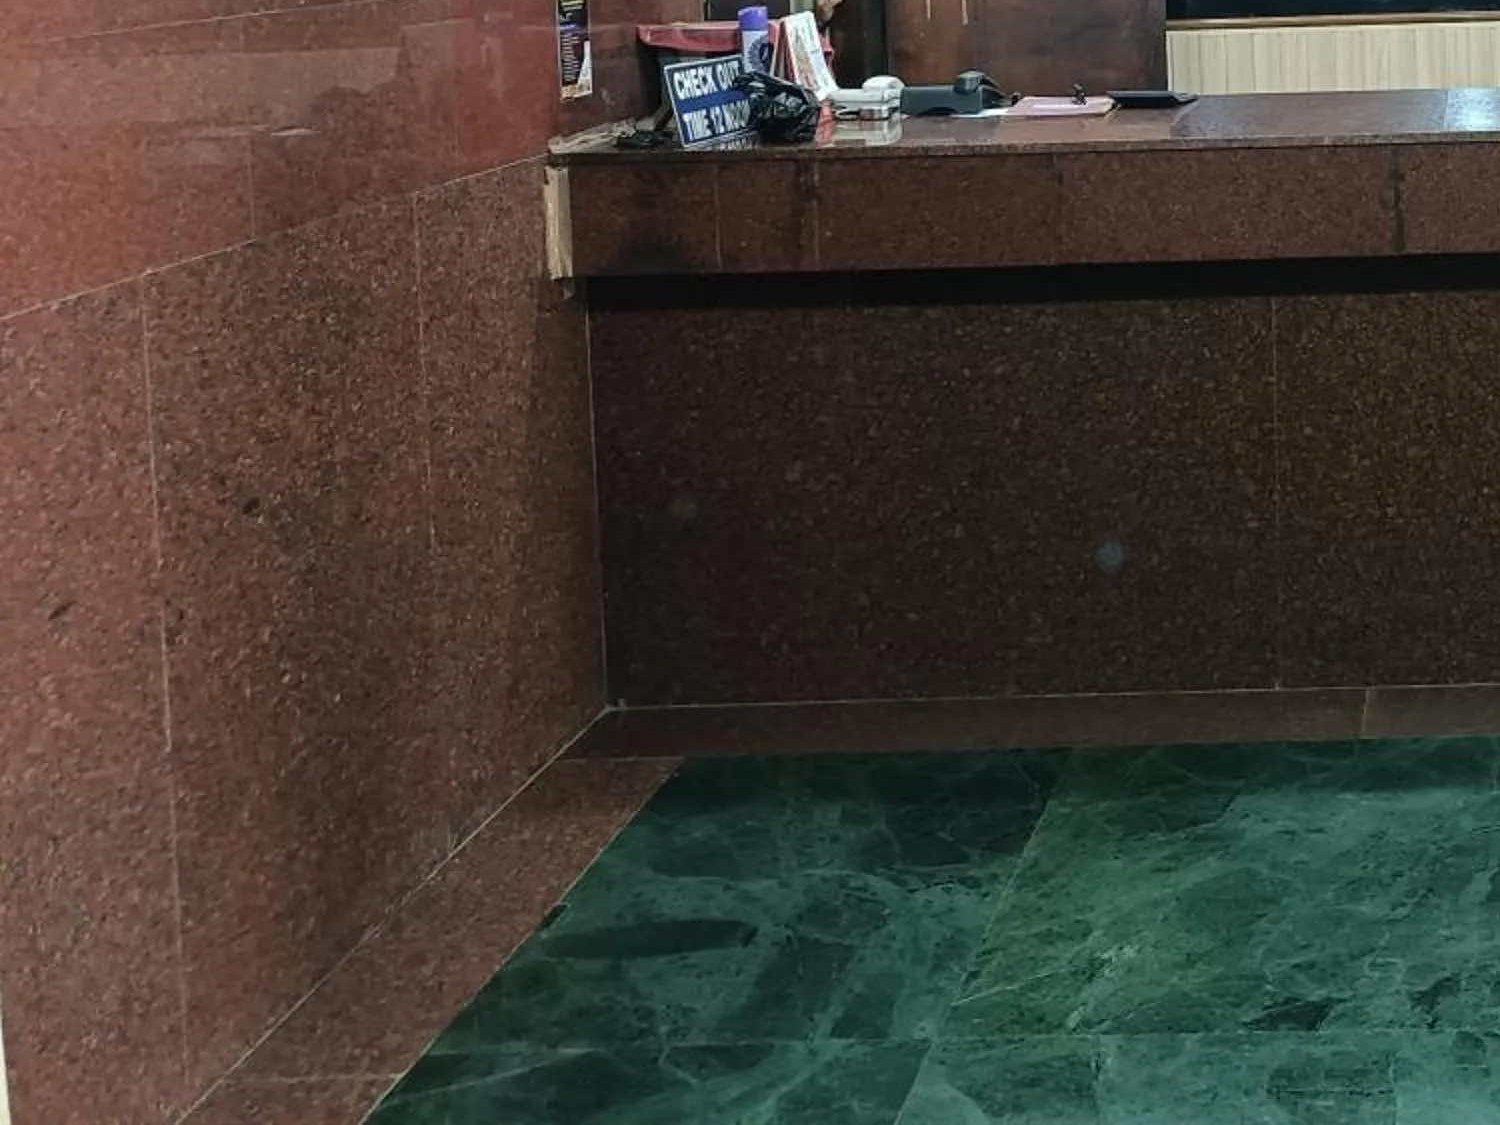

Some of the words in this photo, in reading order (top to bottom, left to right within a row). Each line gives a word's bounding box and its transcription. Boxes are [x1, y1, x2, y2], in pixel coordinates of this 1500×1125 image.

[674, 66, 718, 100] CHECK
[716, 60, 740, 91] OUT
[683, 109, 712, 141] TIME
[710, 106, 725, 134] 12
